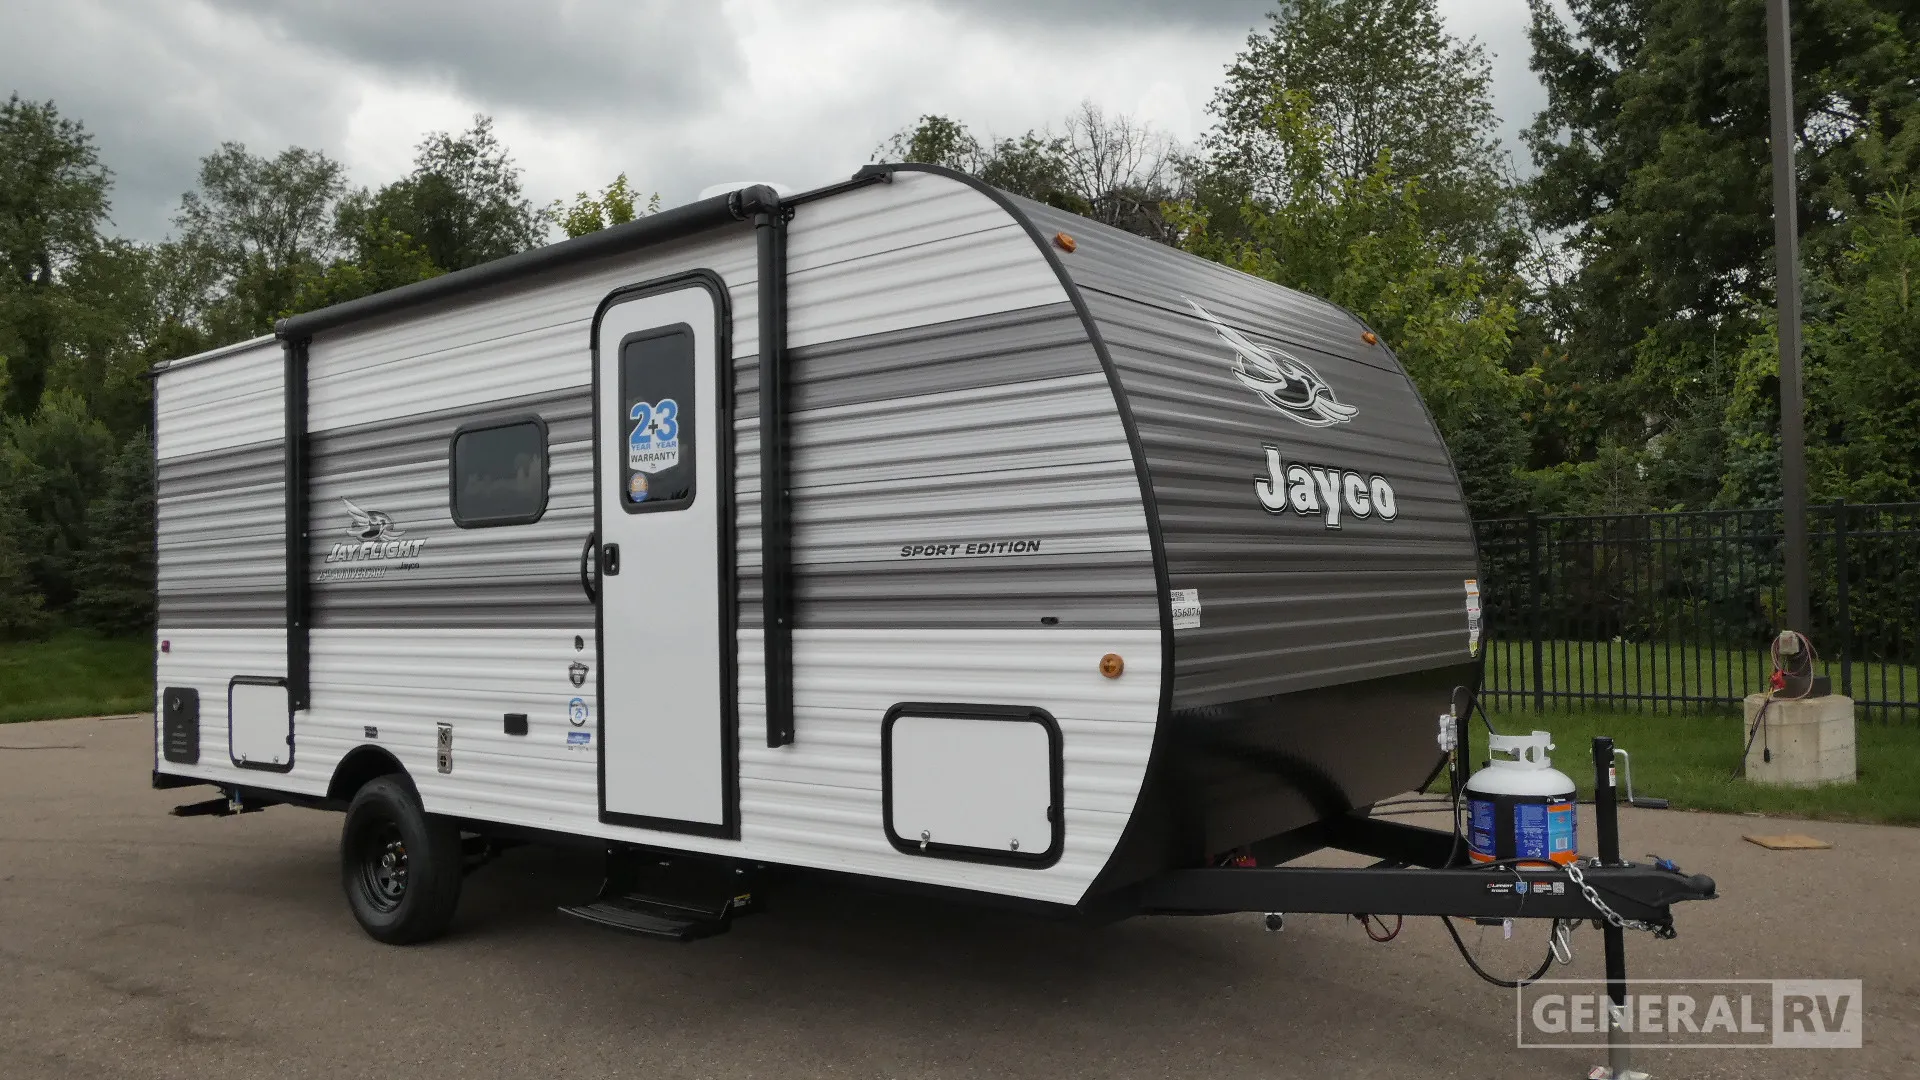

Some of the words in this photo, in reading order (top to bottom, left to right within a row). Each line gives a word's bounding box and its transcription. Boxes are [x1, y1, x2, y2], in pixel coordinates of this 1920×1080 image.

[632, 443, 650, 451] YEAR
[656, 441, 676, 449] YEAR
[631, 451, 677, 463] WARRANTY
[1254, 445, 1398, 529] Jayco
[325, 543, 359, 563] JAY
[359, 539, 426, 561] FLIGHT
[901, 544, 960, 557] SPORT
[965, 540, 1041, 554] EDITION
